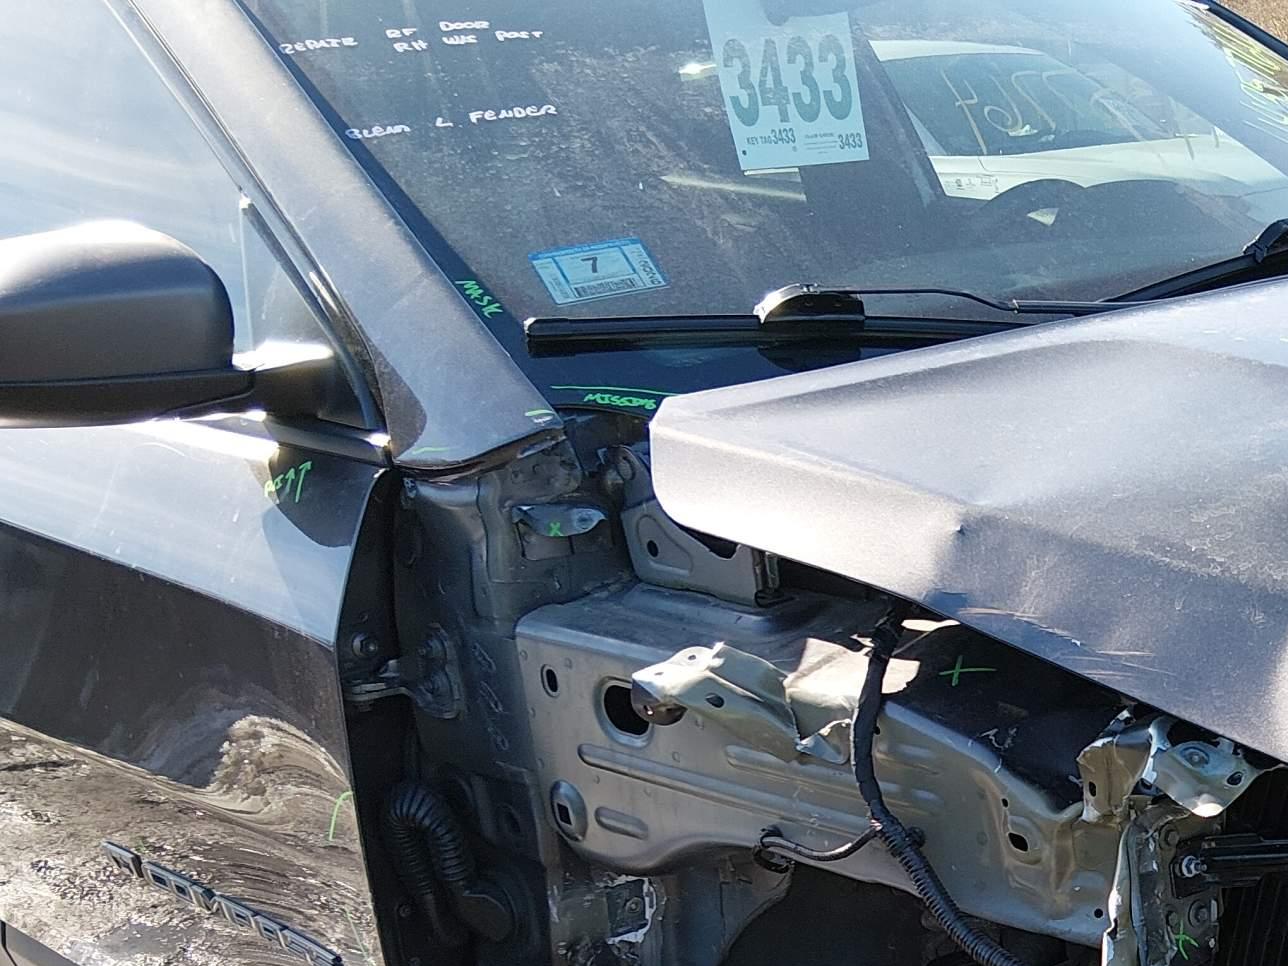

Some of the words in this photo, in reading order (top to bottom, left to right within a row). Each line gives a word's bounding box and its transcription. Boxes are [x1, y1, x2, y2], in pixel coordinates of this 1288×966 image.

[439, 20, 490, 31] DOOR
[393, 41, 430, 52] RH
[722, 34, 853, 127] 3433
[770, 127, 796, 145] 3433
[838, 132, 863, 150] 3433
[580, 256, 599, 274] 7
